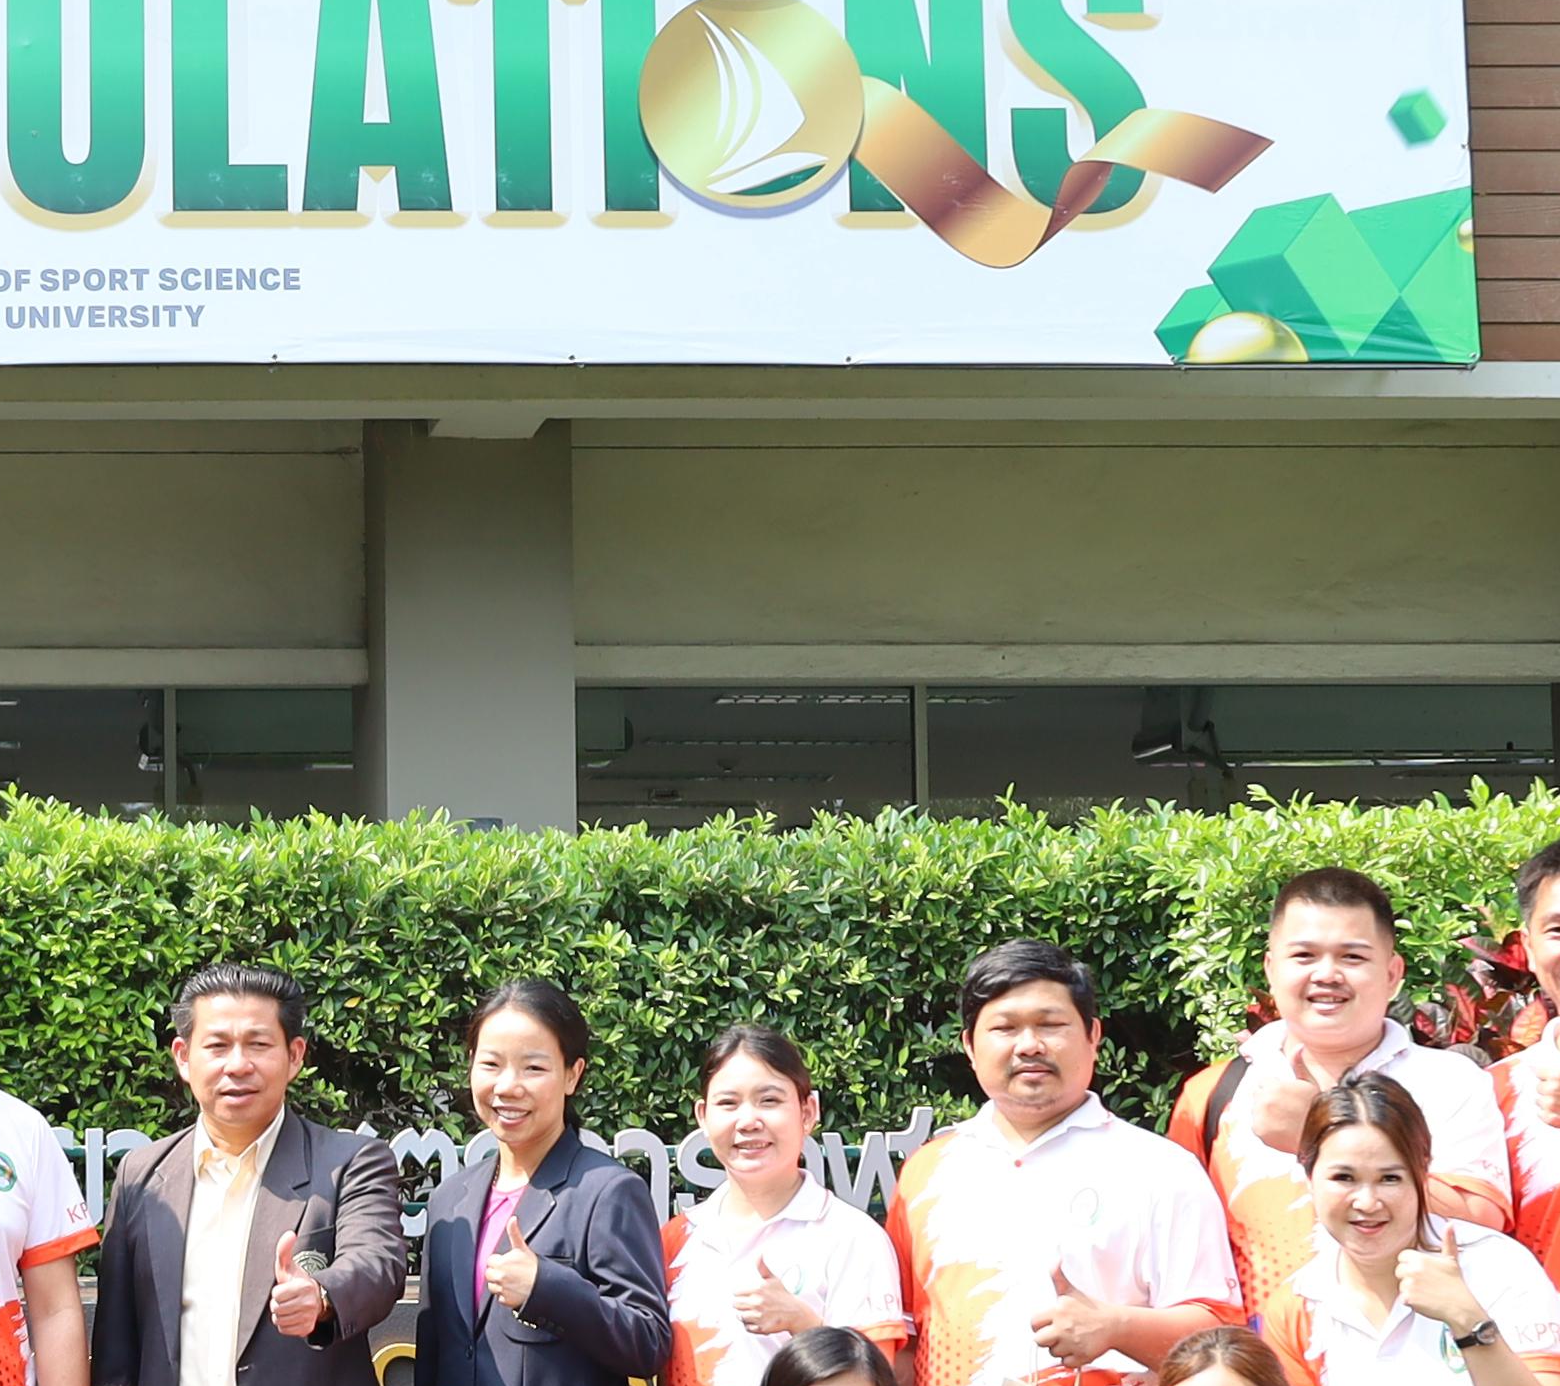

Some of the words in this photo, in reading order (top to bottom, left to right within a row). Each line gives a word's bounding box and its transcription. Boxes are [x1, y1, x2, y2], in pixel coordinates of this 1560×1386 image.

[40, 268, 150, 292] SPORT
[158, 267, 302, 291] SCIENCE
[5, 304, 205, 329] UNIVERSITY
